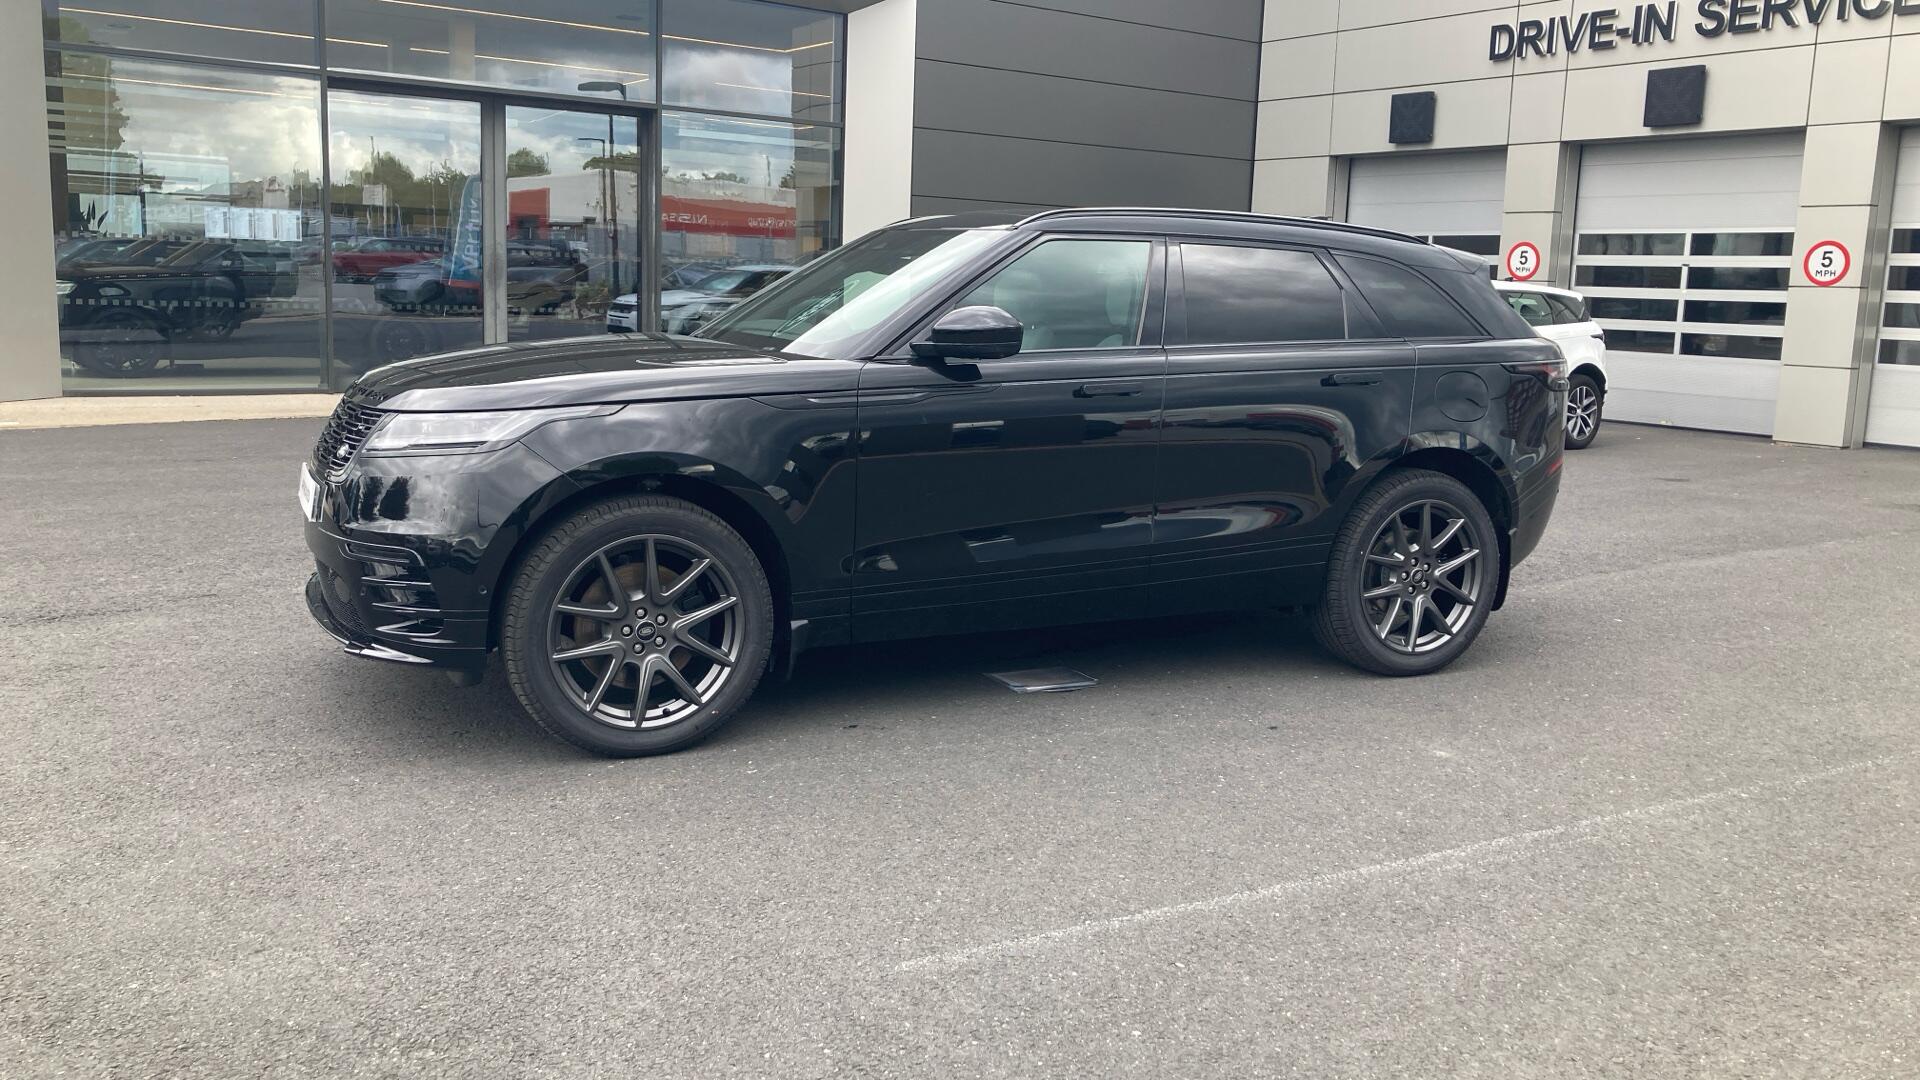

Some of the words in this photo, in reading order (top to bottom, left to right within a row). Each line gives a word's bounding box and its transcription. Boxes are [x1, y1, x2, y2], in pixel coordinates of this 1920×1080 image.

[1488, 0, 1678, 62] DRIVE-IN
[1519, 250, 1529, 265] 5
[1820, 250, 1834, 268] 5
[1815, 269, 1836, 277] MPH
